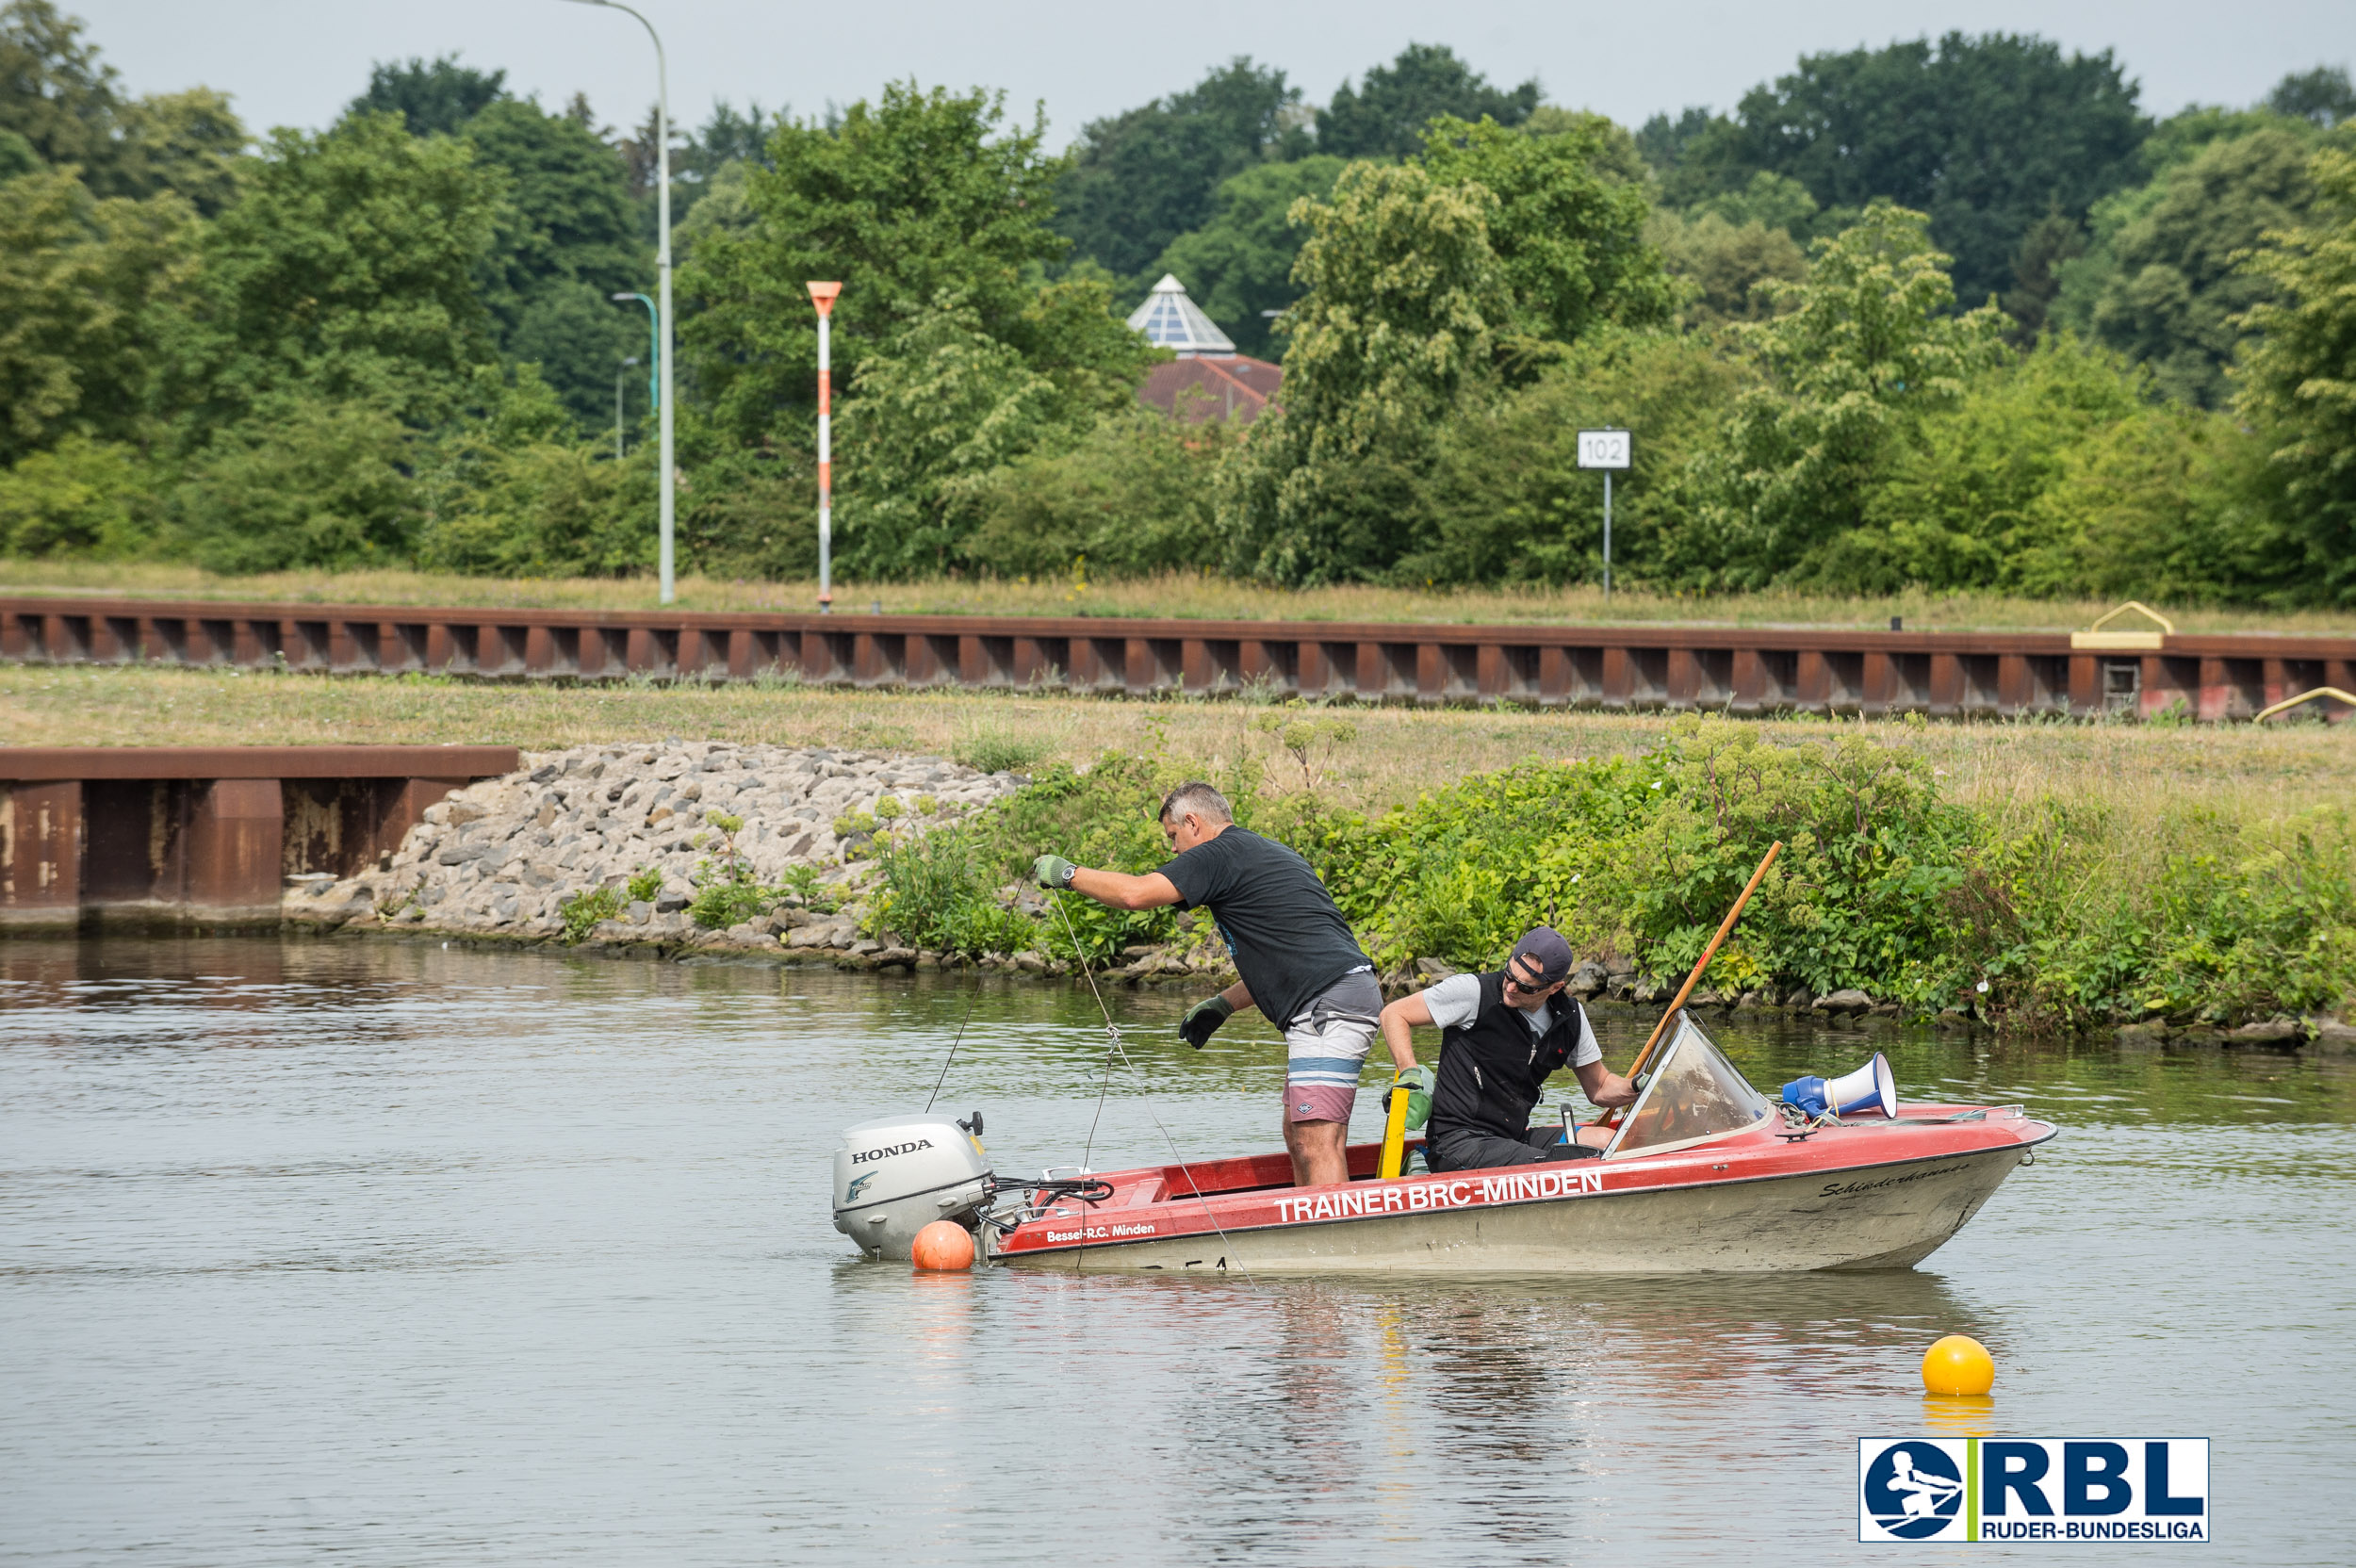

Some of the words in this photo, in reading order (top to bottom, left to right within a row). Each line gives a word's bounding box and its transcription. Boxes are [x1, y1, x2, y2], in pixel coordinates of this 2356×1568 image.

[1585, 438, 1622, 460] 102
[852, 1138, 934, 1165] HONDA
[1046, 1226, 1109, 1243] Bessel-R.C.
[1112, 1222, 1155, 1237] Minden
